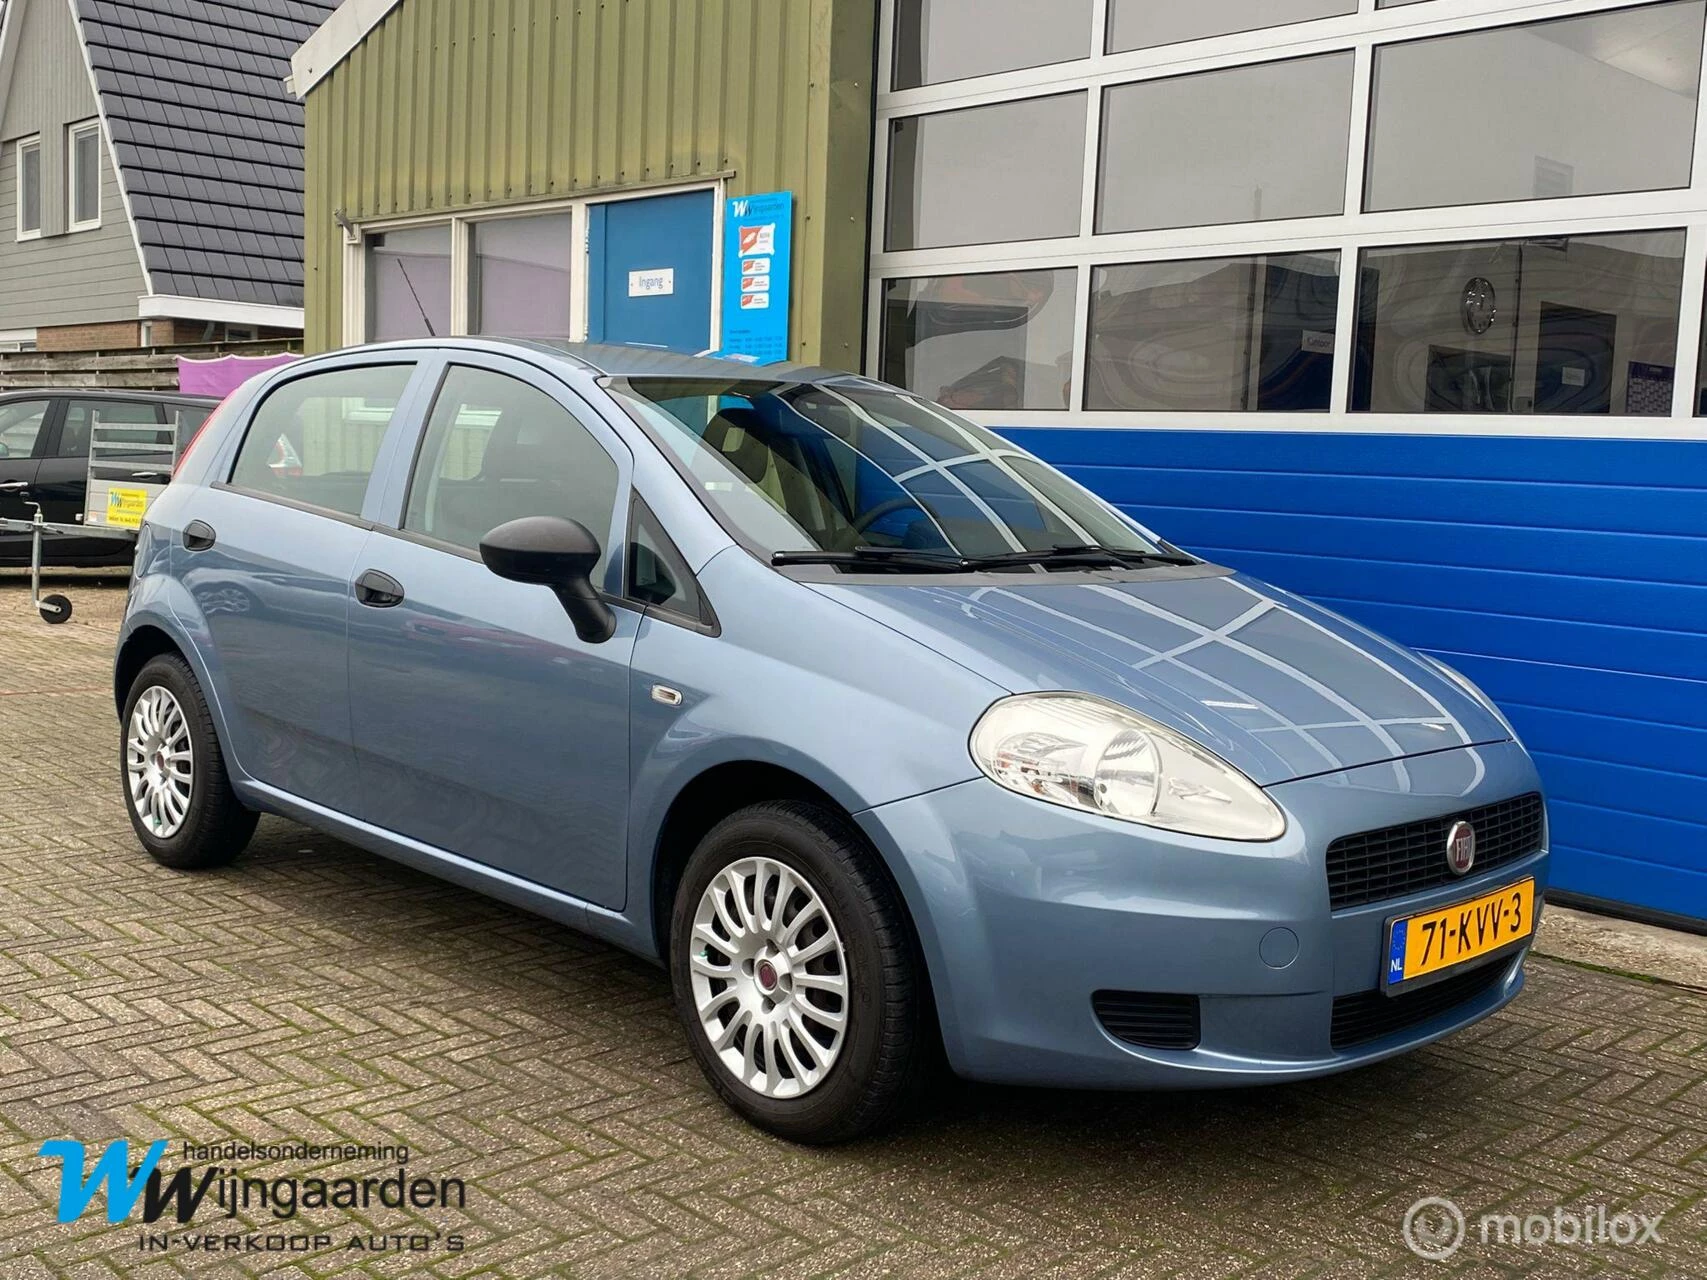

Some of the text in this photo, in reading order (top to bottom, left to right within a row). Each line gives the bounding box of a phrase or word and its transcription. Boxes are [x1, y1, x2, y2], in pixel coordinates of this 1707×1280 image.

[639, 276, 664, 290] Ingang
[1420, 891, 1522, 967] 71-KVV-3
[1390, 957, 1403, 973] NL
